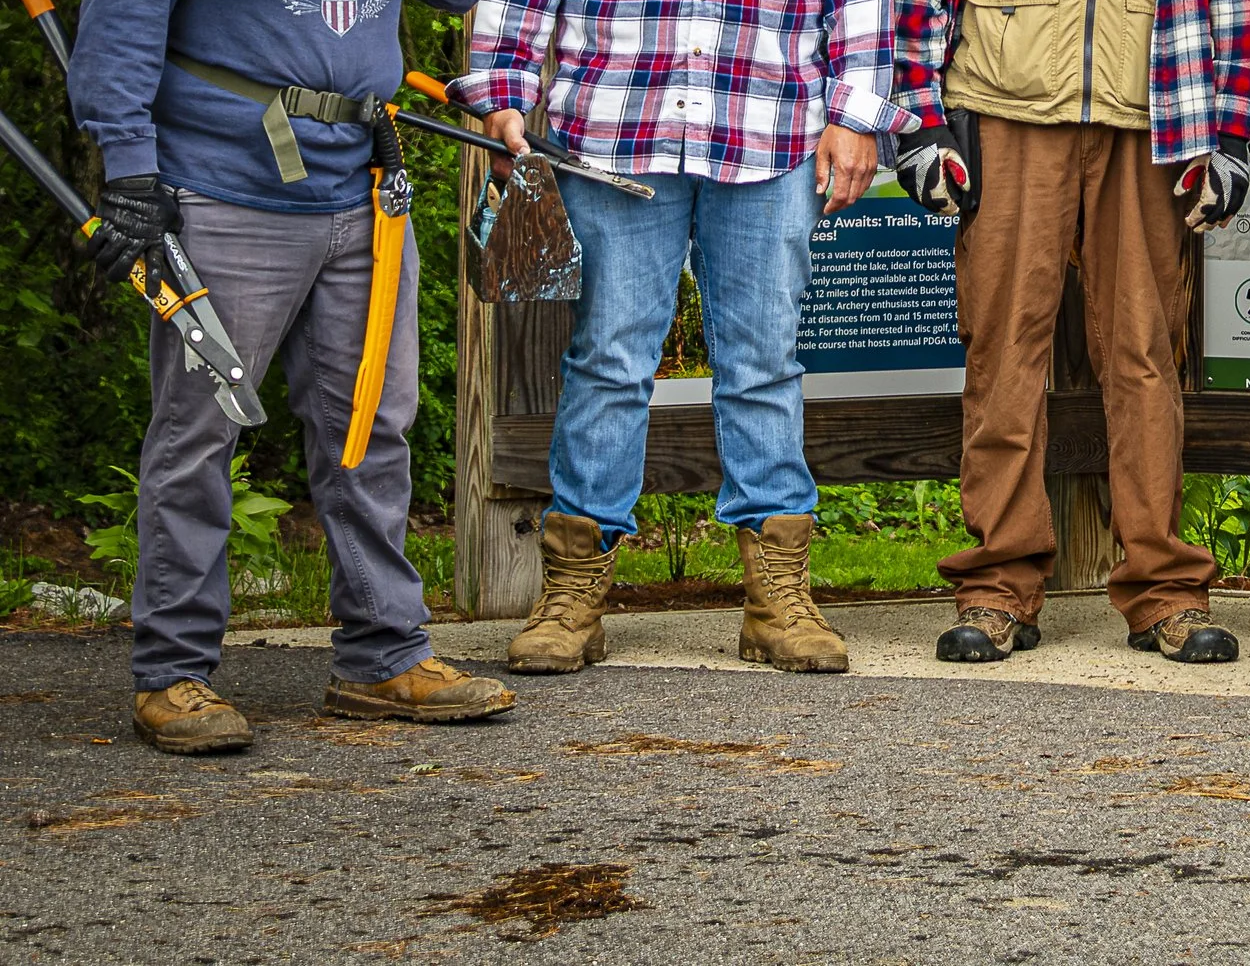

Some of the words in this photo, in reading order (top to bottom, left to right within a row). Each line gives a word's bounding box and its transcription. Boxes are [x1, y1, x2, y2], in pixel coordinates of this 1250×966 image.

[833, 214, 881, 228] Awaits:
[884, 213, 921, 229] Trails,
[827, 251, 833, 259] a
[834, 248, 864, 261] variety
[865, 248, 874, 258] of
[875, 247, 909, 258] outdoor
[911, 246, 950, 258] activities,
[820, 262, 851, 272] around
[853, 261, 867, 271] the
[869, 261, 888, 271] lake,
[890, 260, 910, 270] ideal
[912, 259, 924, 269] for
[831, 274, 868, 287] camping
[869, 273, 906, 283] available
[908, 274, 916, 282] at
[918, 272, 939, 282] Dock
[815, 288, 824, 298] 12
[826, 287, 849, 298] miles
[850, 287, 859, 297] of
[861, 287, 875, 297] the
[877, 285, 918, 296] statewide
[919, 284, 954, 296] Buckeye
[812, 301, 834, 313] park.
[836, 300, 870, 312] Archery
[871, 298, 919, 309] enthusiasts
[920, 299, 936, 307] can
[807, 315, 816, 324] at
[817, 313, 858, 324] distances
[859, 312, 880, 322] from
[882, 312, 892, 321] 10
[893, 311, 910, 321] and
[912, 311, 921, 320] 15
[923, 311, 953, 320] meters
[818, 326, 832, 337] For
[834, 326, 858, 336] those
[860, 324, 903, 335] interested
[904, 324, 912, 333] in
[914, 323, 930, 333] disc
[932, 322, 950, 334] golf,
[817, 340, 846, 349] course
[848, 338, 865, 348] that
[867, 337, 890, 348] hosts
[892, 336, 921, 347] annual
[922, 335, 946, 345] PDGA
